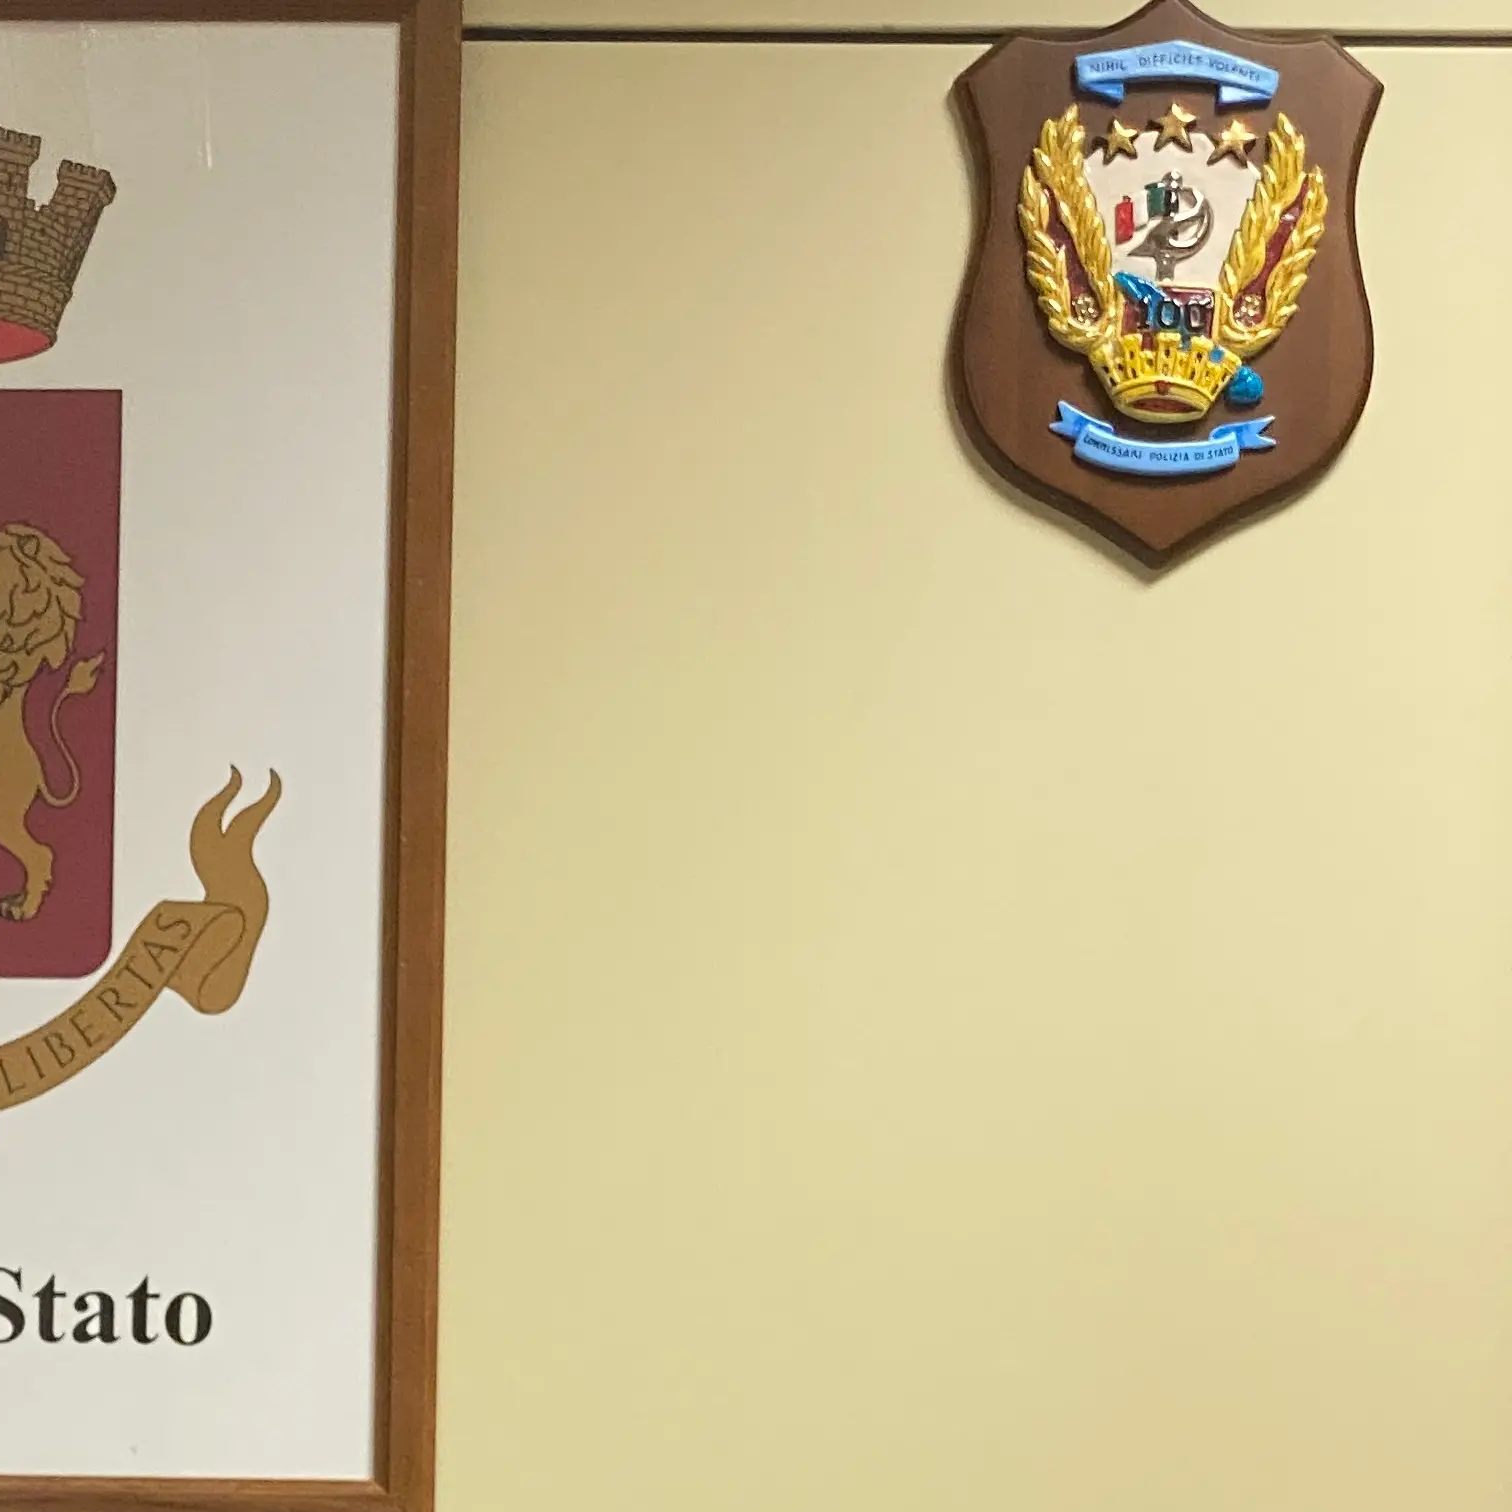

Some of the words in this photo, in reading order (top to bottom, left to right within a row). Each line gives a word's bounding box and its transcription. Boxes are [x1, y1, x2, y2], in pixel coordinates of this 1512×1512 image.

[1149, 451, 1189, 463] POLIZIA
[1194, 452, 1205, 461] DI
[1206, 446, 1235, 461] STATO
